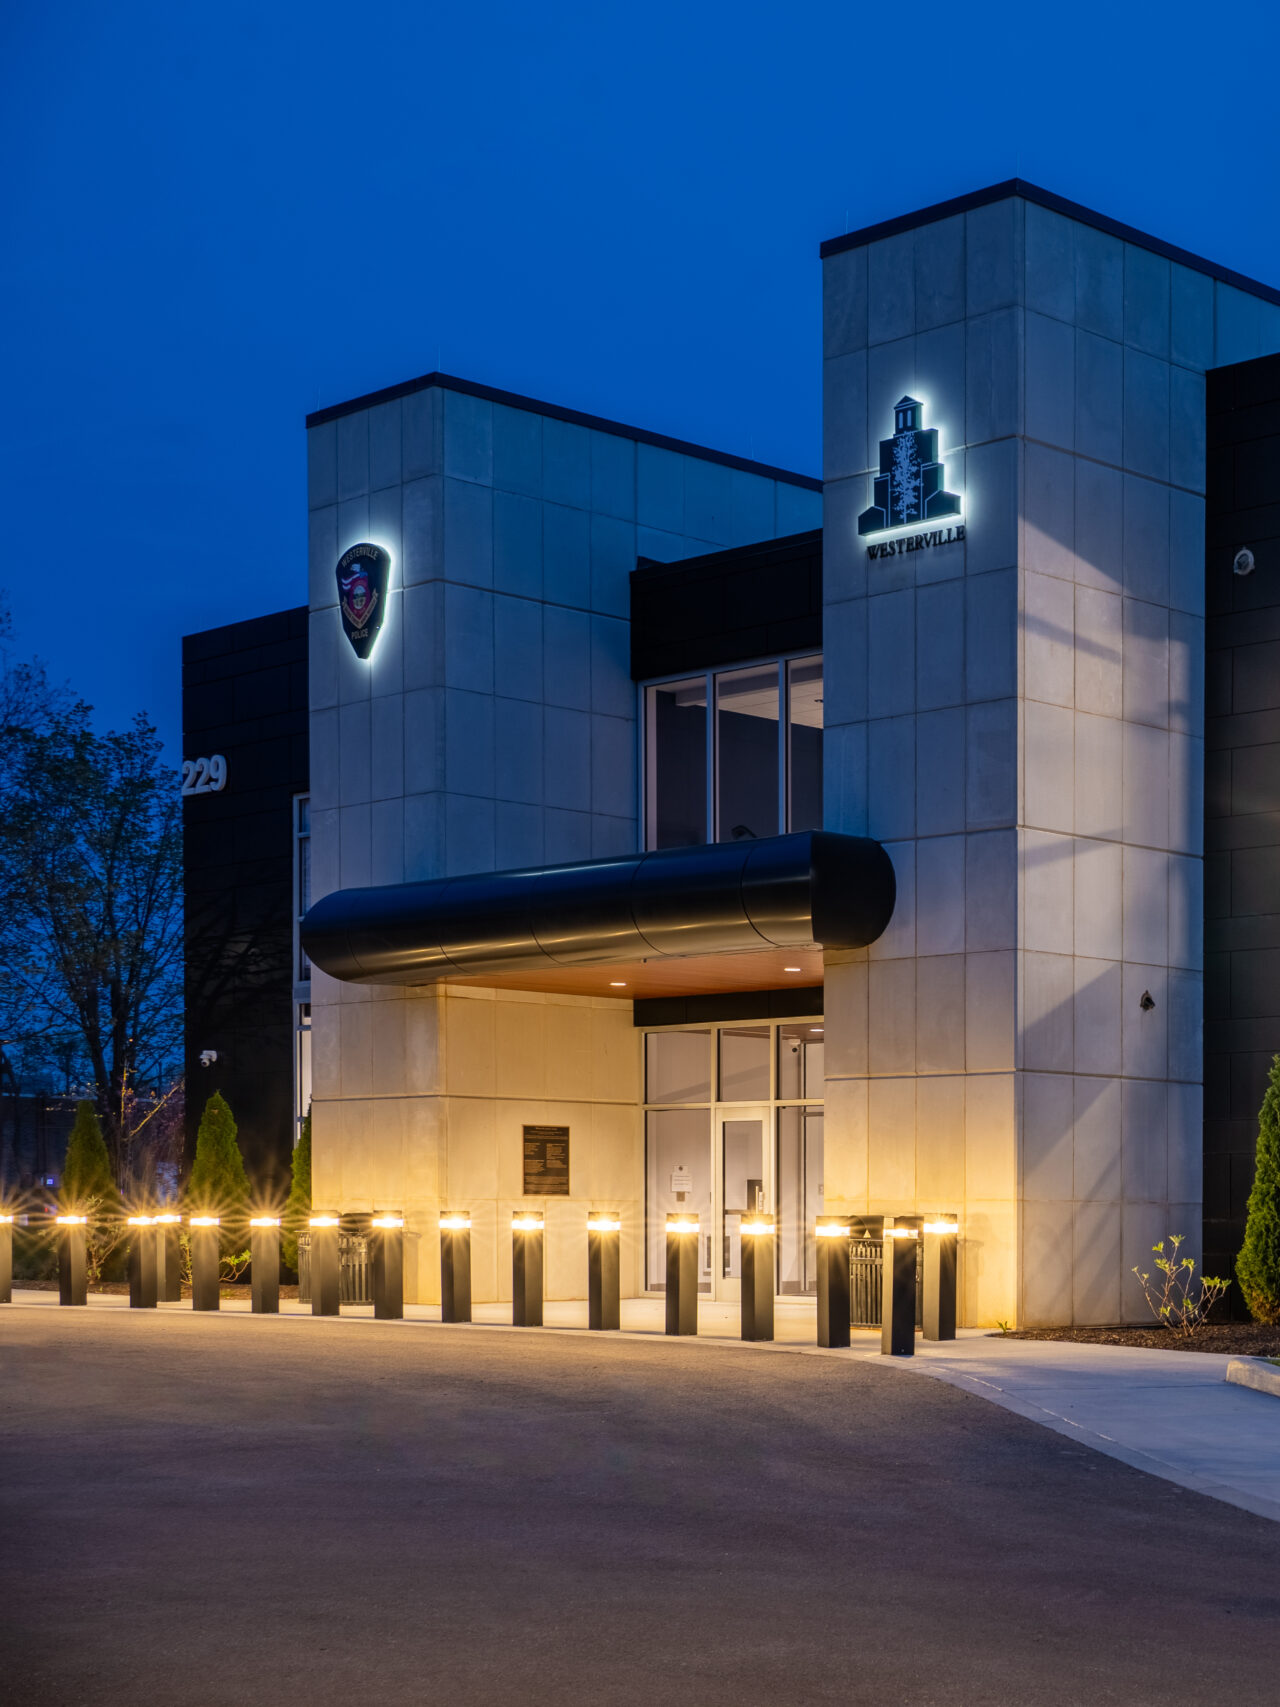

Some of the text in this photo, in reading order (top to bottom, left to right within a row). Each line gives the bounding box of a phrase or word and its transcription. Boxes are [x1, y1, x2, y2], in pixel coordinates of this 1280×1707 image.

[341, 546, 378, 568] WESTERVILLE
[866, 525, 965, 561] WESTERVILLE
[351, 628, 369, 640] POLICE
[181, 754, 227, 796] 229
